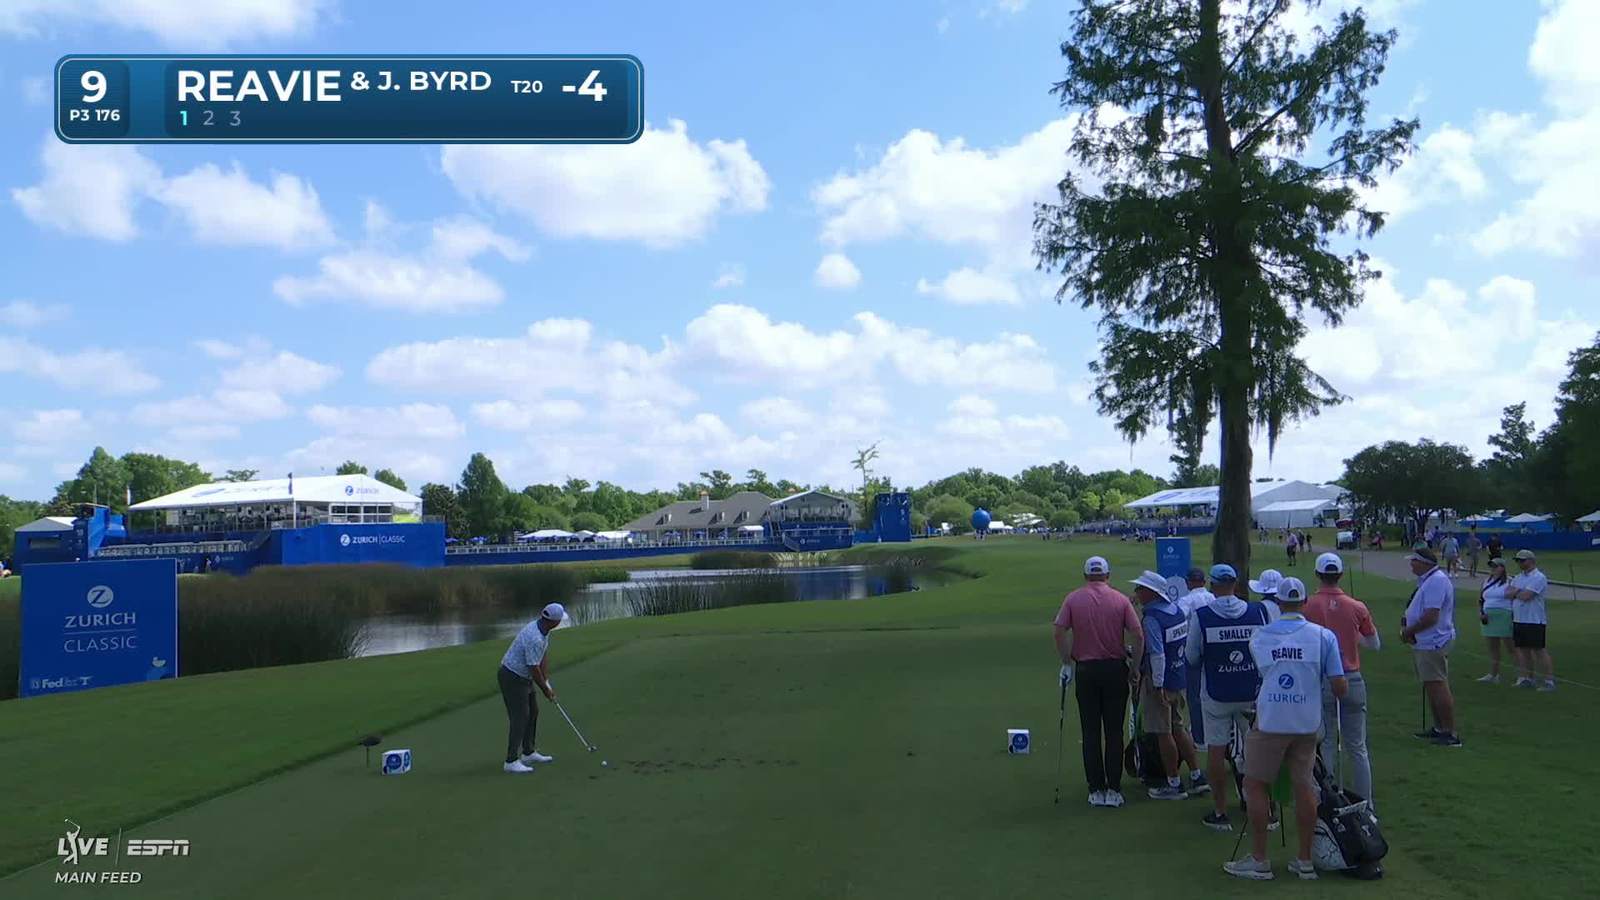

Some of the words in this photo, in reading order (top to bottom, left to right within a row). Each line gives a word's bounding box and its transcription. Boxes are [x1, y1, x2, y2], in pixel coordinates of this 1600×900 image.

[352, 535, 378, 544] ZURICH
[380, 535, 406, 544] CLASSIC
[64, 612, 136, 628] ZURICH
[1219, 628, 1252, 641] SMALLEY
[63, 636, 137, 653] CLASSIC
[1271, 648, 1303, 661] REAVIE
[1218, 663, 1255, 673] ZURICH
[1268, 693, 1307, 705] ZURICH
